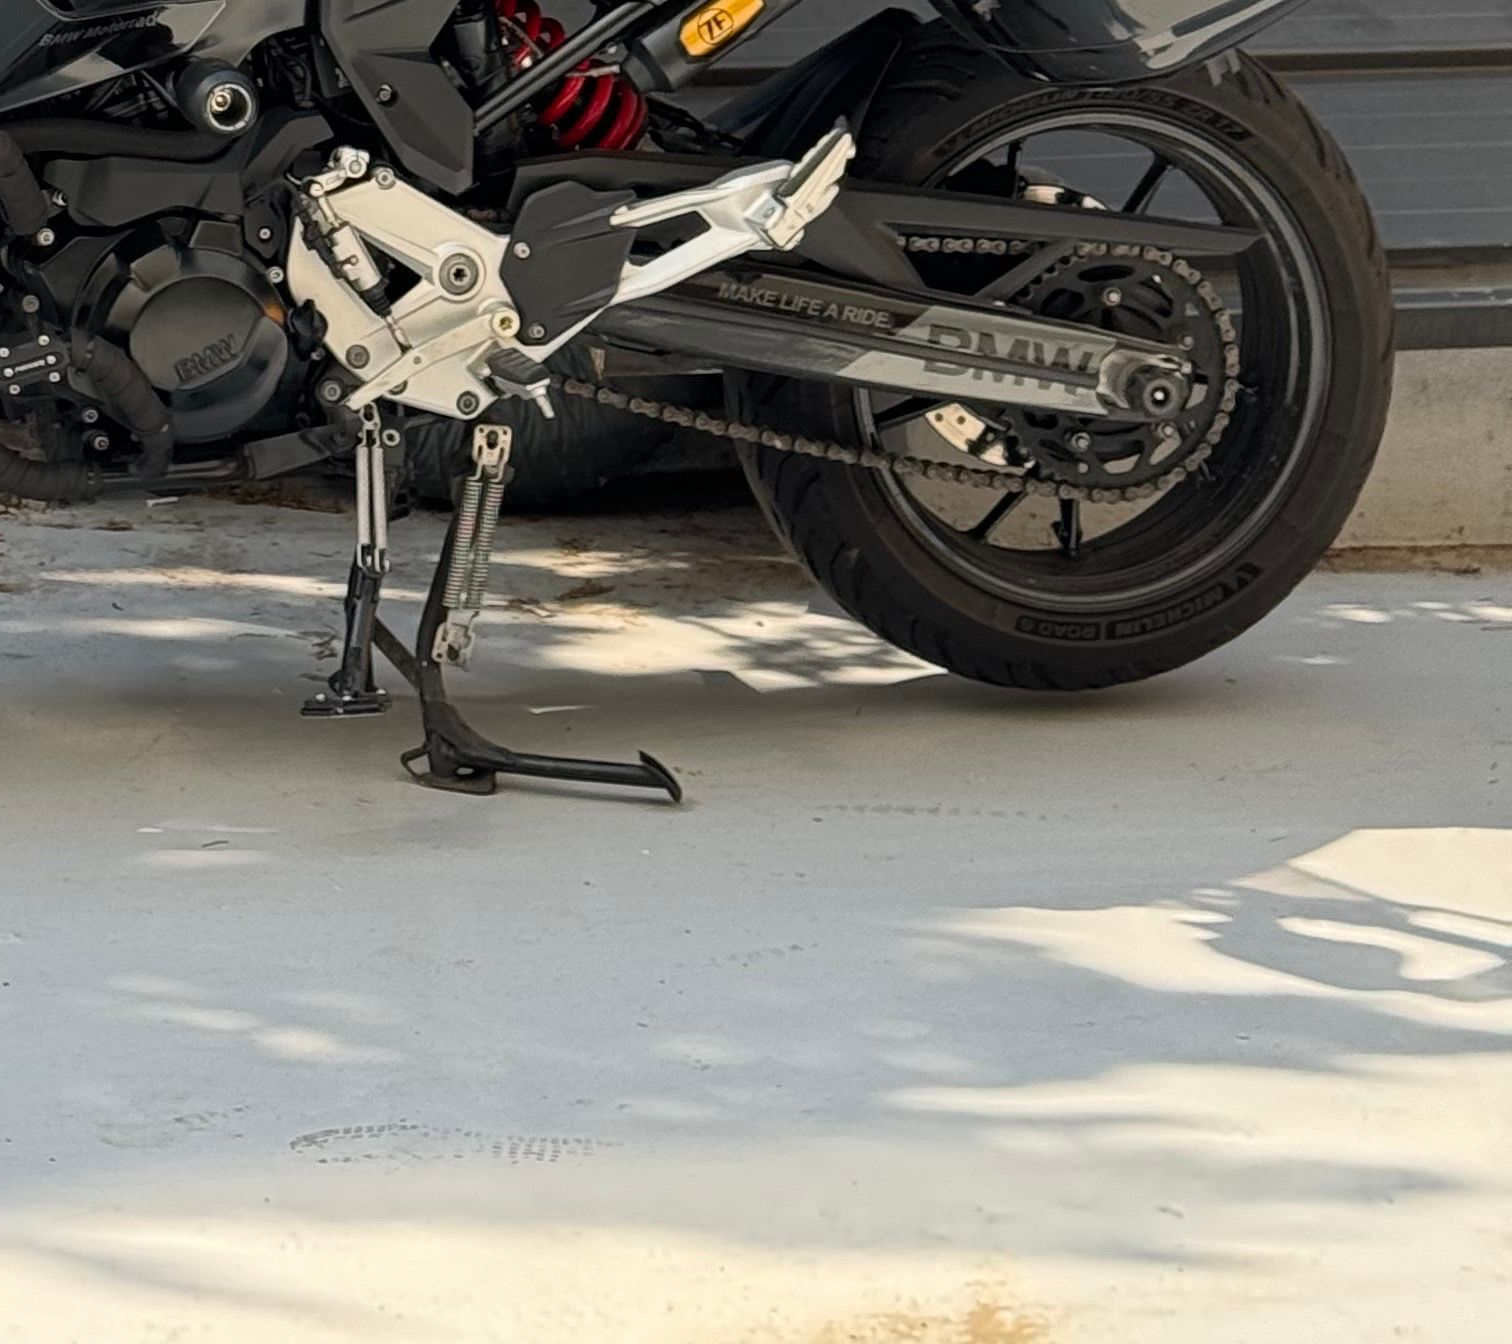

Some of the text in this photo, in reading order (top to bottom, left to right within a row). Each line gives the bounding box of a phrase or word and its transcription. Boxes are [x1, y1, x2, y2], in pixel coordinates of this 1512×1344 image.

[699, 10, 729, 42] ZF
[718, 282, 778, 308] MAKE
[779, 293, 823, 316] LIFE
[822, 302, 839, 320] A
[174, 333, 238, 383] BMW
[923, 323, 1093, 396] BMW
